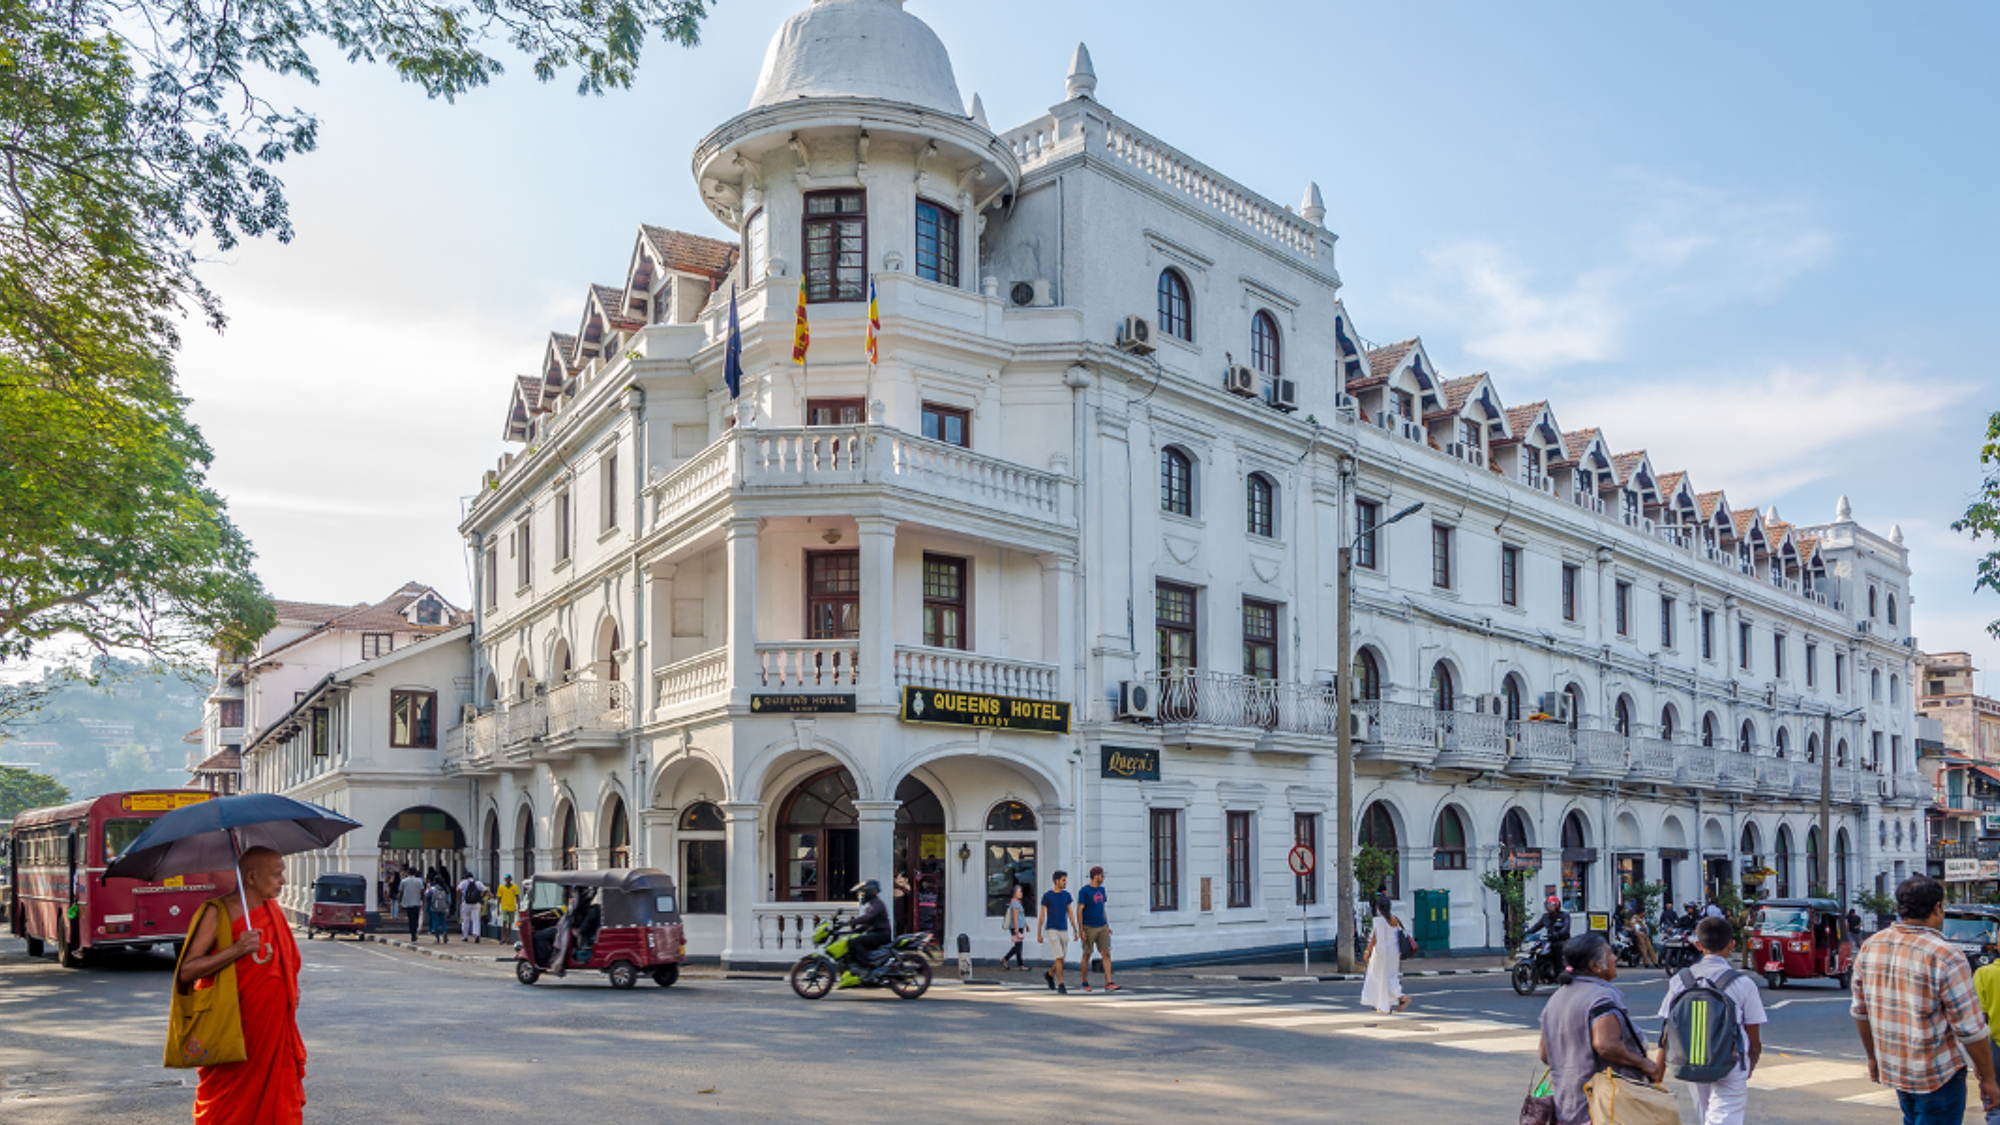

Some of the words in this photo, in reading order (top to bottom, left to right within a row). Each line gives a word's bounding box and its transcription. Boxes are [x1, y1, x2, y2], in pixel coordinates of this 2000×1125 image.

[812, 696, 846, 705] HOTEL
[934, 693, 1000, 715] QUEEN'S
[1011, 700, 1061, 720] HOTEL
[973, 715, 1010, 727] KANDY
